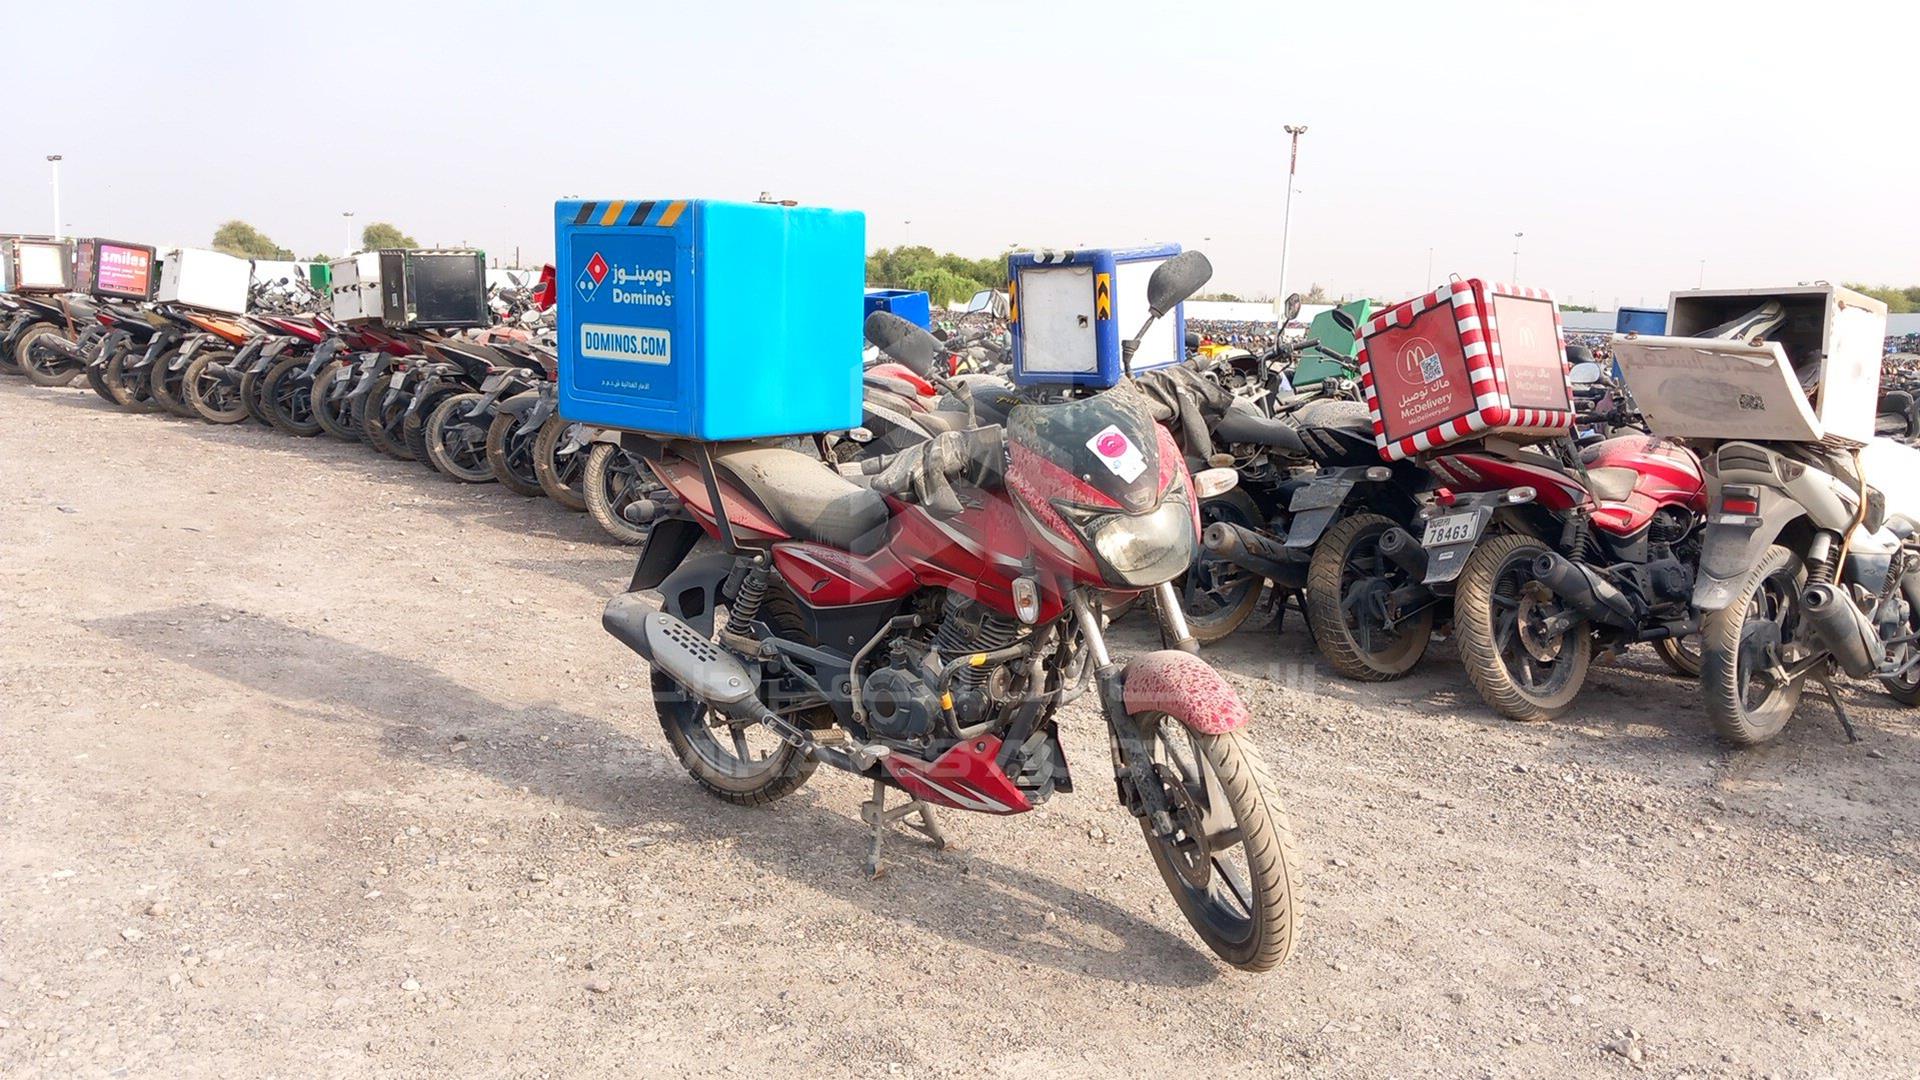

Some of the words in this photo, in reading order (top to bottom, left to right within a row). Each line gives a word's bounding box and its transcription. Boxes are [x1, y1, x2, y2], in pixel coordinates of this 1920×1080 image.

[102, 251, 146, 267] smiles
[611, 263, 672, 287] دومينوز
[612, 288, 672, 307] Domino's
[585, 332, 666, 357] DOMINOS.COM
[1431, 378, 1450, 392] ماك
[1398, 386, 1428, 408] توصيل
[1400, 392, 1452, 419] McDelivery
[1429, 524, 1469, 543] 78463
